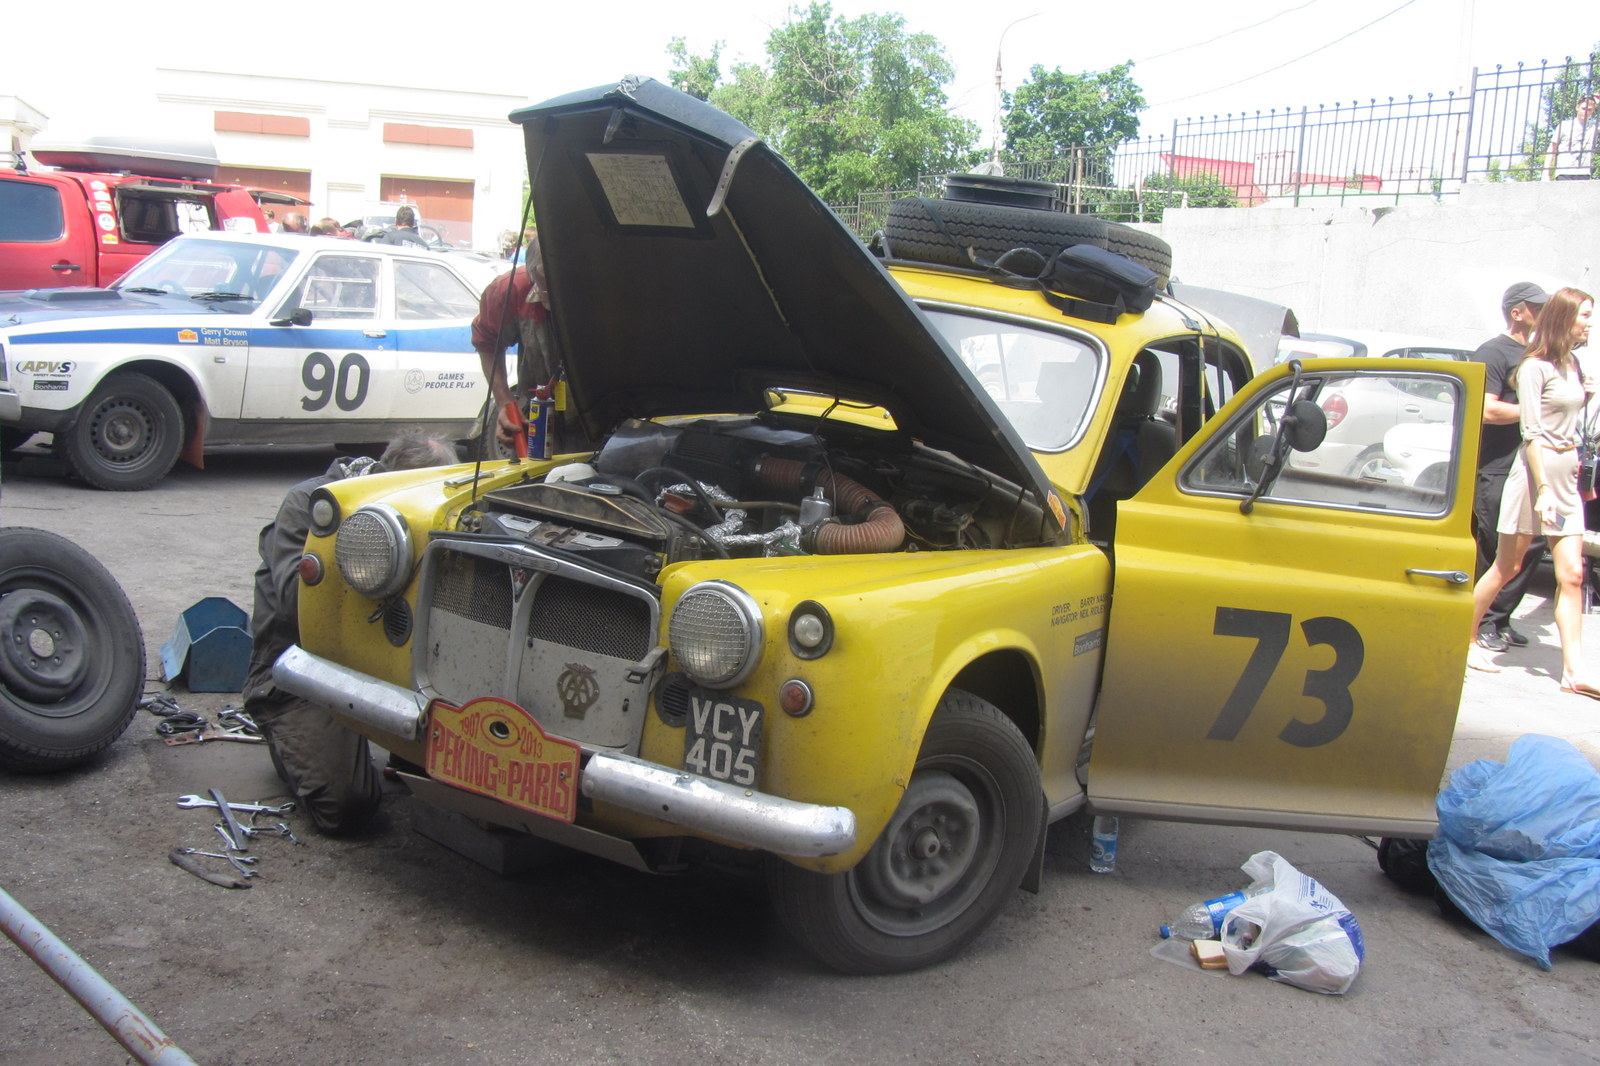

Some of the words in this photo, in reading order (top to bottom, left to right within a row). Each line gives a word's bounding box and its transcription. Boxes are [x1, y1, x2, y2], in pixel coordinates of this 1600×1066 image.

[201, 328, 221, 336] Gerry
[204, 337, 220, 345] Matt
[223, 338, 248, 346] Bryson
[300, 351, 370, 412] 90
[425, 381, 454, 389] PEOPLE
[438, 373, 465, 381] GAMES
[1206, 606, 1365, 748] 73
[460, 712, 481, 740] 1907
[692, 697, 759, 746] VCY
[519, 726, 543, 759] 2013
[431, 718, 499, 791] PEKING
[507, 759, 573, 814] PARIS
[686, 738, 755, 785] 405
